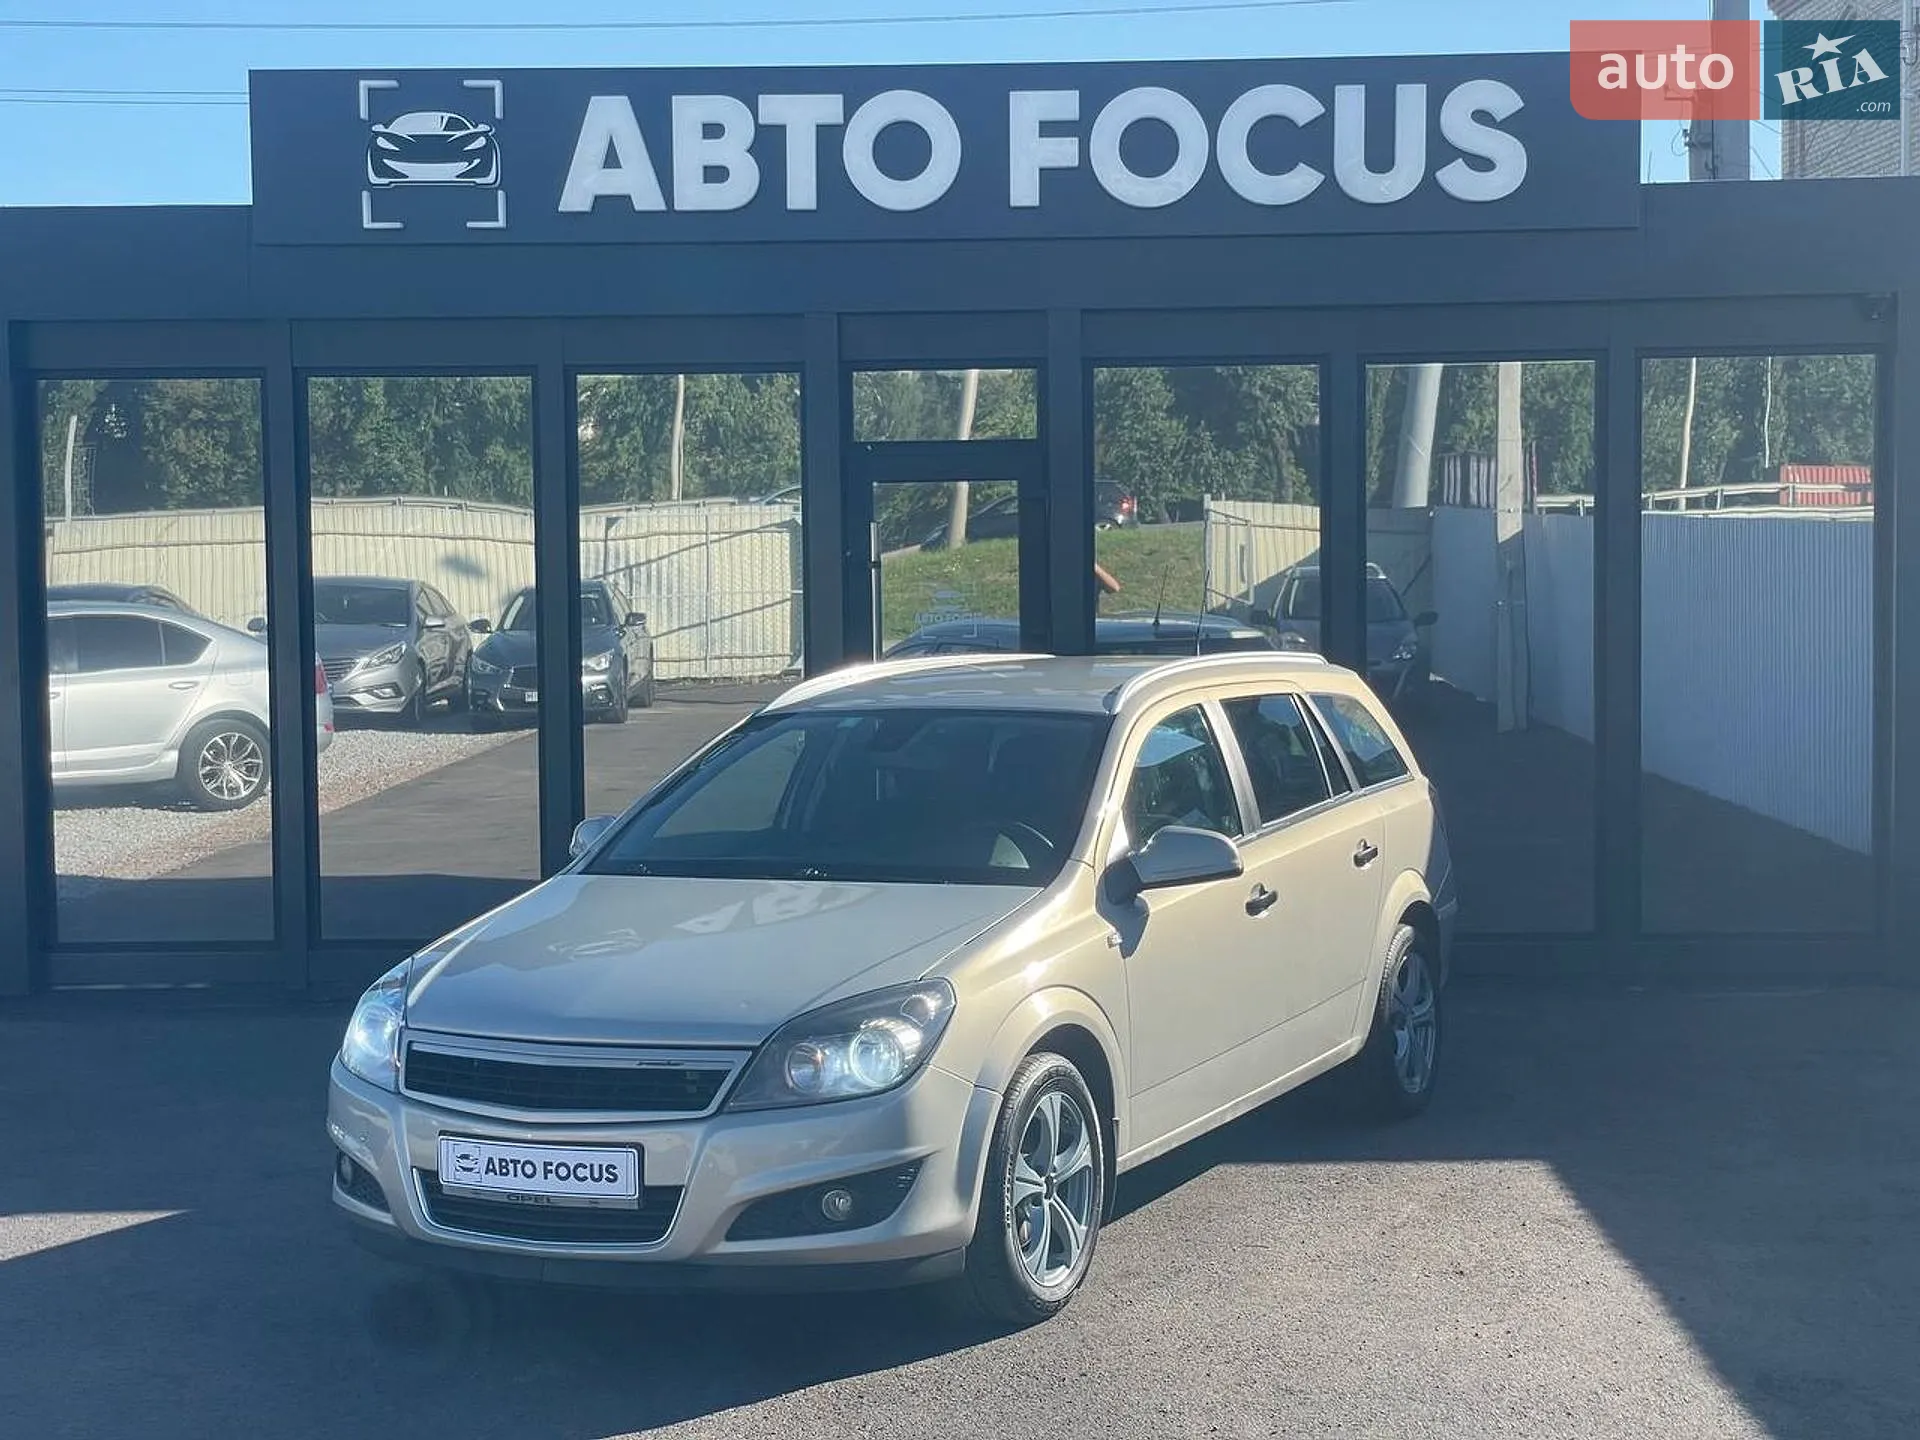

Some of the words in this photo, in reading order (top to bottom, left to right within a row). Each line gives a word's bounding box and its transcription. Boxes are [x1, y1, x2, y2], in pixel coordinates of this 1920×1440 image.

[558, 89, 961, 212] АВТО
[1009, 79, 1527, 208] FOCUS
[484, 1156, 537, 1179] АВТО
[543, 1161, 618, 1183] FOCUS
